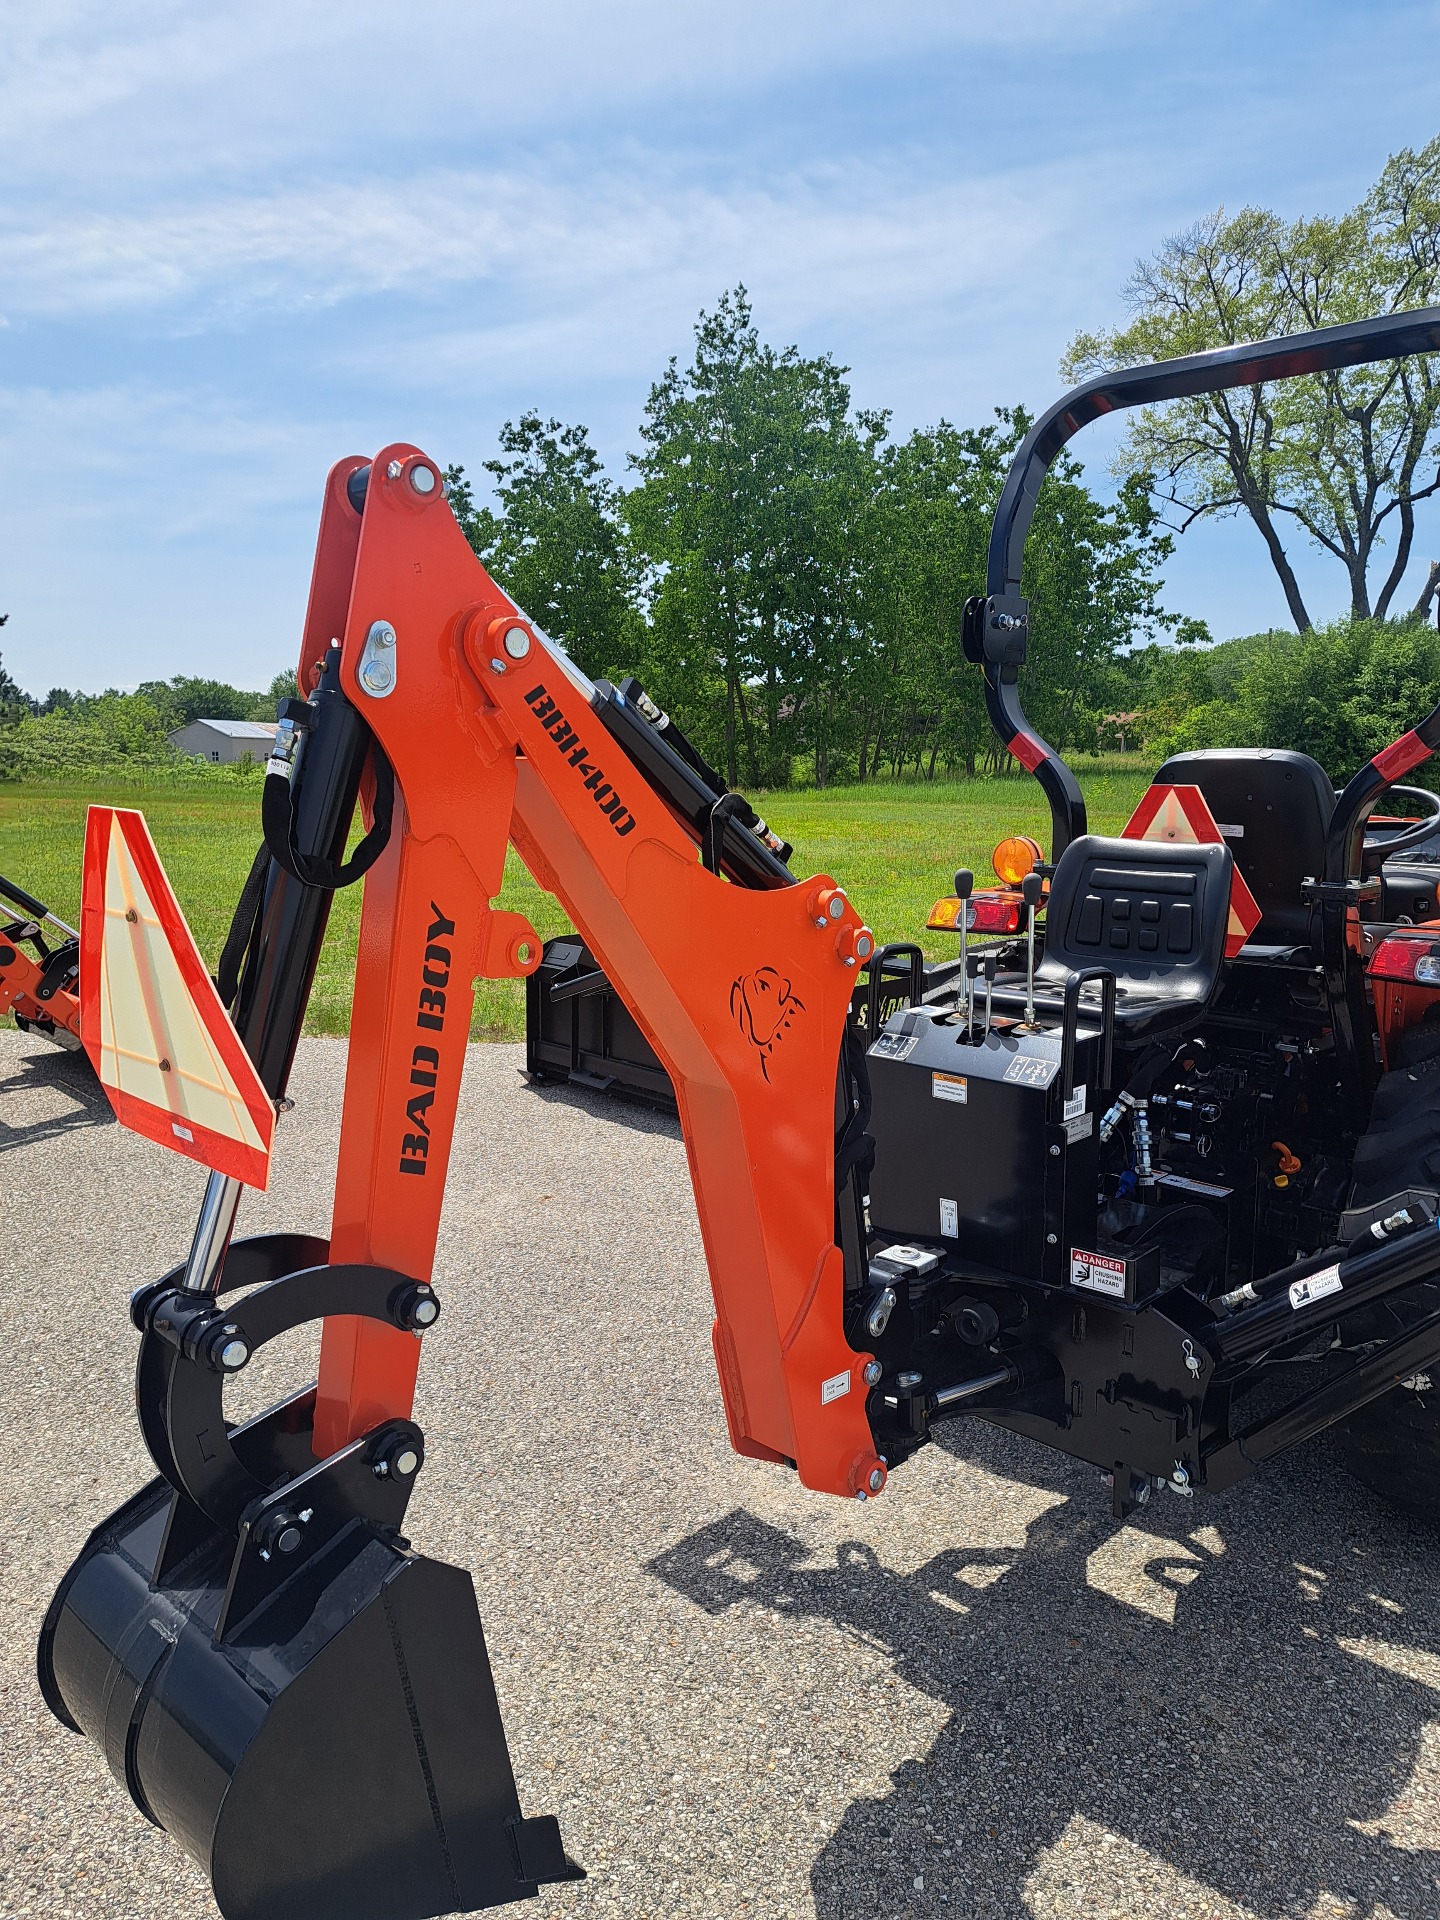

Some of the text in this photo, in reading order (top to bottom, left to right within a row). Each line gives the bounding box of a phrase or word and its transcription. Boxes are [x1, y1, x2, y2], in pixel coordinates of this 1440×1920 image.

[523, 684, 636, 837] BBH400
[399, 899, 456, 1176] BAD BOY
[1082, 1254, 1121, 1272] DANGER
[1095, 1270, 1123, 1283] CRUSHING
[1097, 1278, 1120, 1288] HAZARD
[1314, 1279, 1335, 1291] HAZARD
